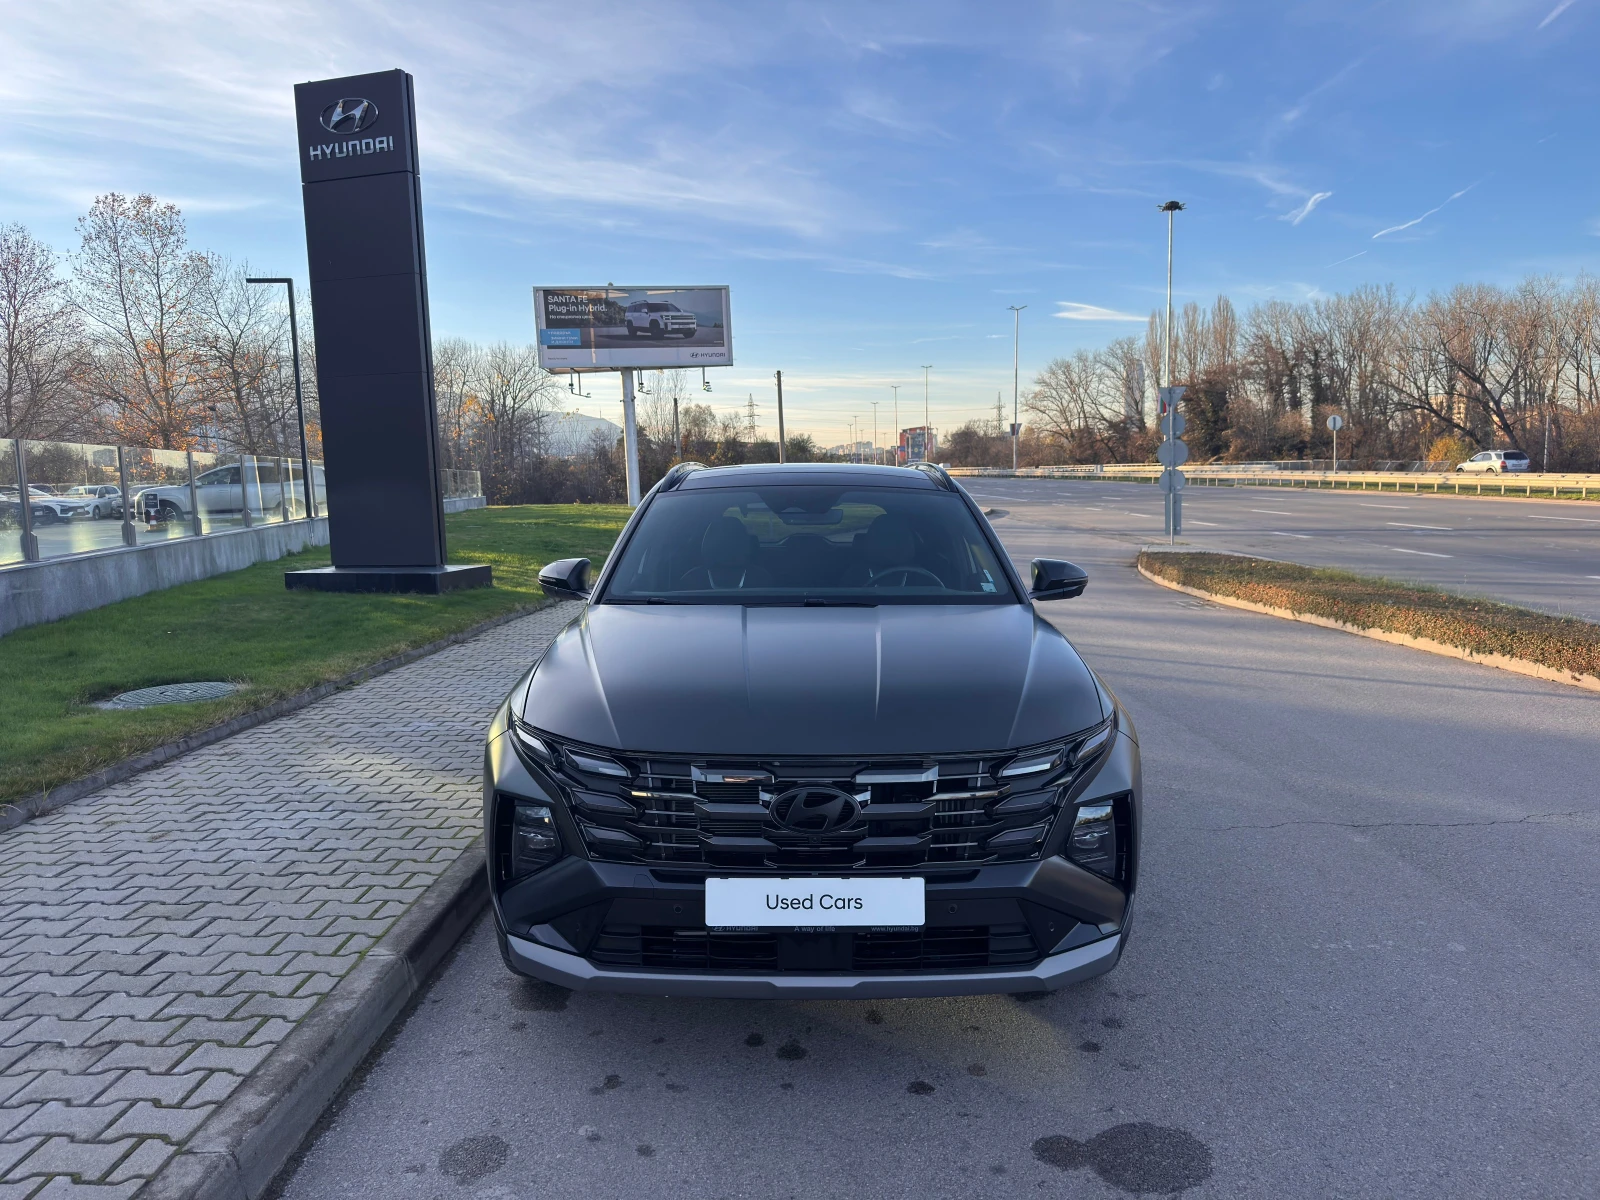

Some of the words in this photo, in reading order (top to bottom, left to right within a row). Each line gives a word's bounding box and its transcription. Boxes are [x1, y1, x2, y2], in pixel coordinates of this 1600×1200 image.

[309, 135, 394, 161] HYUNDAI
[547, 295, 576, 303] SANTA
[577, 295, 588, 303] FE
[548, 304, 577, 313] Plug-in
[578, 303, 608, 313] Hybrid.
[766, 894, 813, 910] Used
[819, 894, 863, 910] Cars
